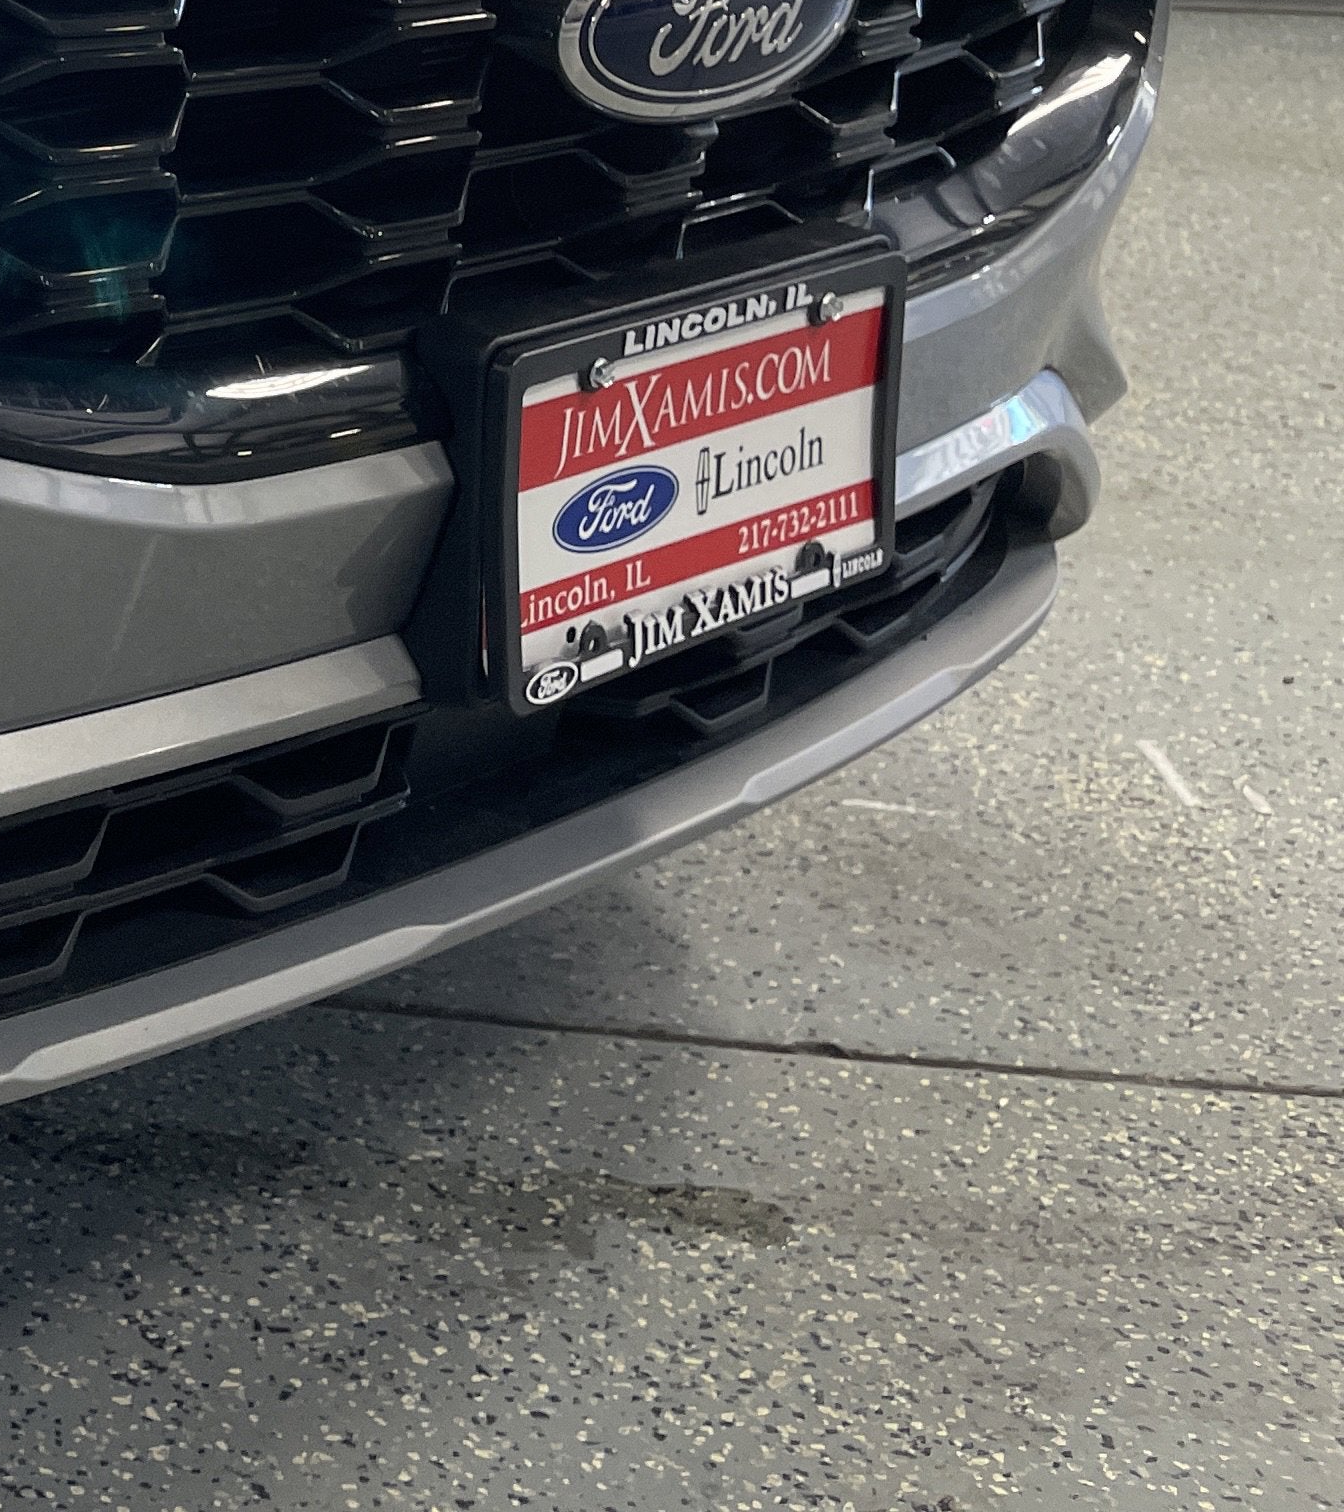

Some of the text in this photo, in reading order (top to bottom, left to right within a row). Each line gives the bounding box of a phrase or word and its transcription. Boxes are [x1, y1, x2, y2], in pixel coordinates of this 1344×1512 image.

[624, 283, 812, 356] LINCOLN, IL
[554, 340, 831, 479] JIMXAMIS.COM
[711, 427, 824, 500] Lincoln
[578, 480, 652, 540] Ford
[738, 491, 858, 554] 217-732-2111
[625, 560, 651, 591] IL
[628, 568, 789, 668] JIM XAMIS
